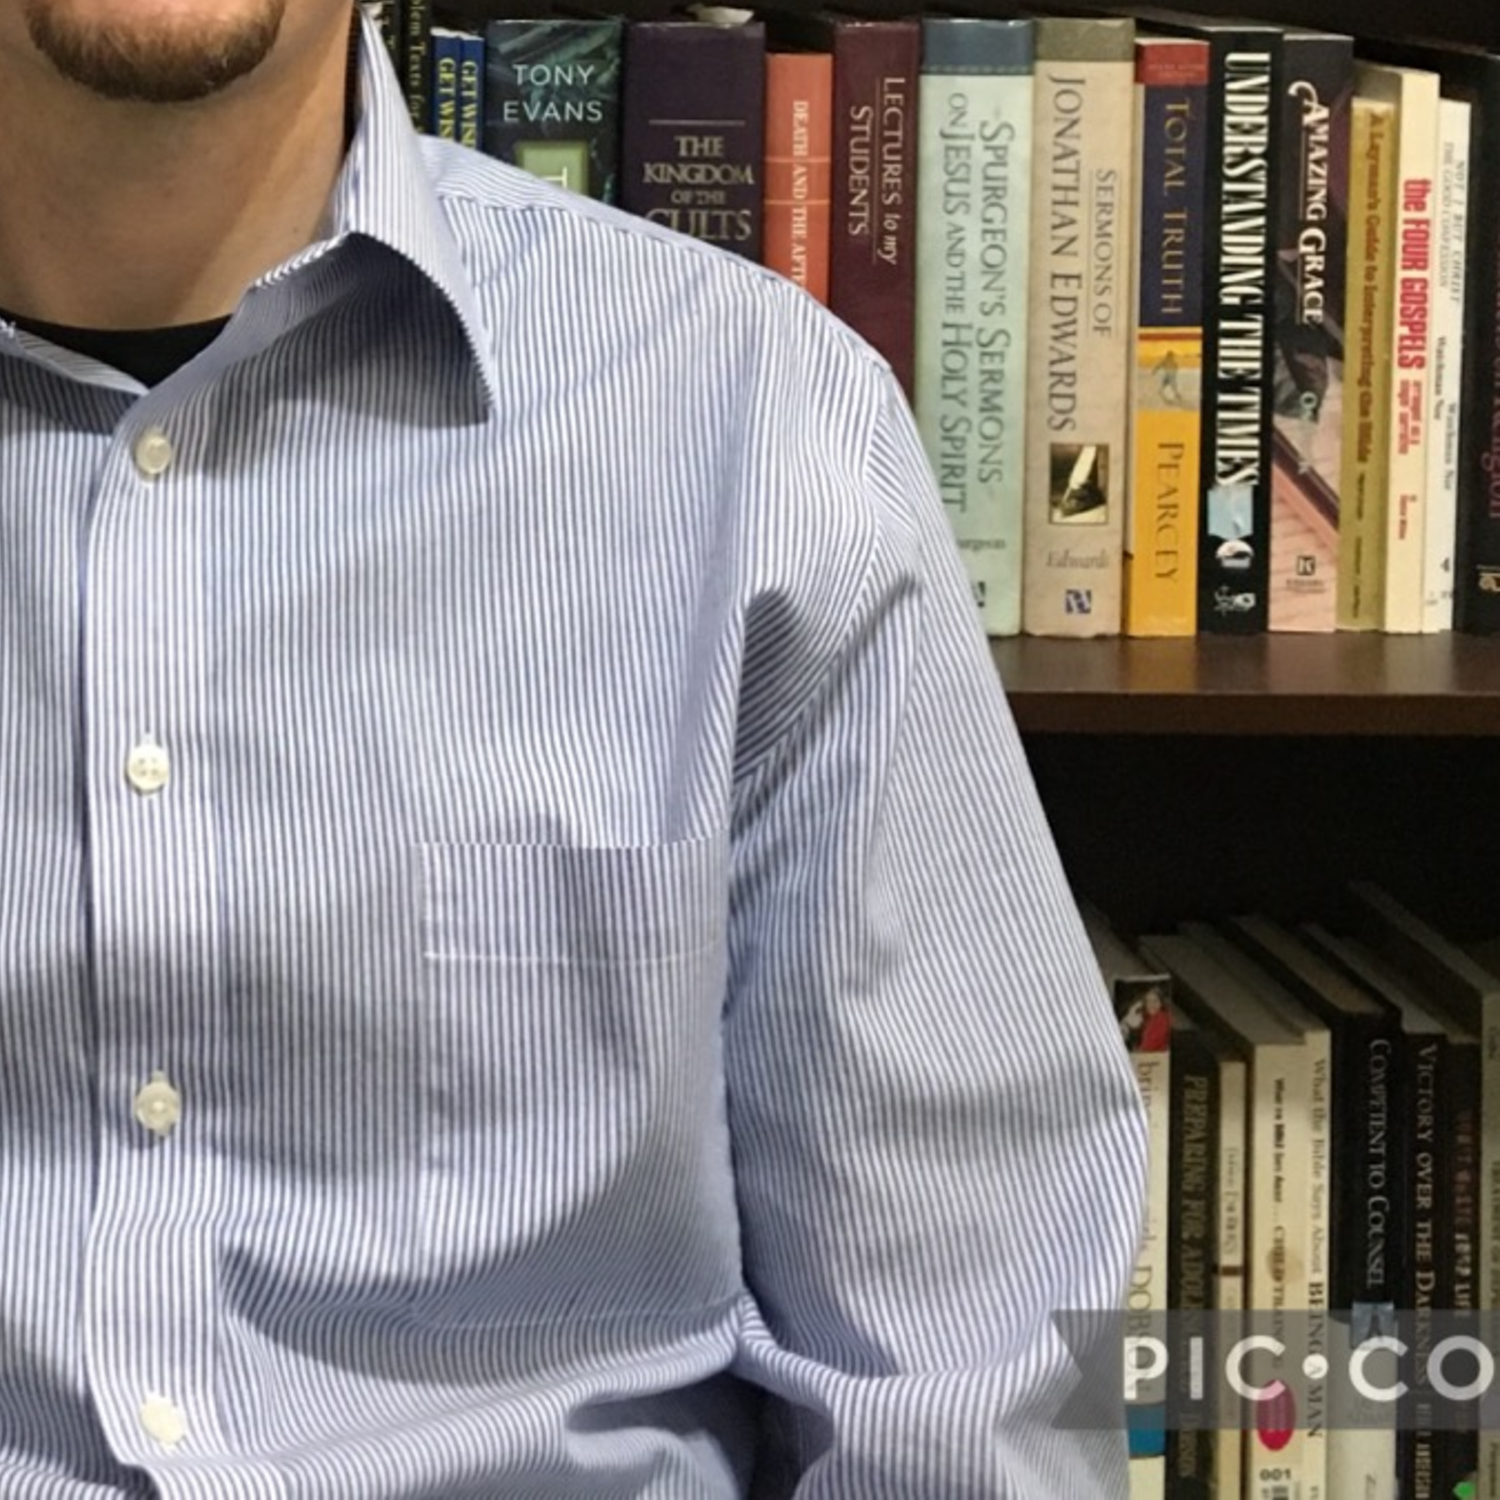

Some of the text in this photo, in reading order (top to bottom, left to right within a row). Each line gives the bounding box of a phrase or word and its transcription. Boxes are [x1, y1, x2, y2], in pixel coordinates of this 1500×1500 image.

[503, 101, 603, 122] EVANS
[512, 64, 595, 86] TONY
[643, 164, 754, 184] KINGDOM
[675, 137, 723, 157] THE
[792, 100, 808, 237] DEATH AND THE
[849, 106, 873, 235] STUDENTS
[878, 76, 905, 264] LECTURES to my
[1163, 99, 1189, 196] TOTAL
[1288, 80, 1329, 324] AMAZING GRACE
[1404, 178, 1431, 212] the
[940, 93, 975, 513] ON JESUS AND THE HOLY SPIRIT
[975, 120, 1015, 484] SPURGEON'S SERMONS
[1047, 74, 1086, 432] JONATHAN EDWARDS
[1093, 169, 1117, 337] SERMONS OF
[1161, 205, 1188, 314] TRUTH
[1216, 52, 1270, 486] UNDERSTANDING THE TIMES
[1401, 218, 1431, 270] FOUR
[1397, 277, 1429, 370] GOSPELS
[1154, 442, 1184, 584] PEARCEY
[1367, 1038, 1392, 1289] COMPETENT TO COUNSEL
[1415, 1043, 1438, 1263] VICTORY OVER THE
[1260, 1469, 1292, 1481] 001
